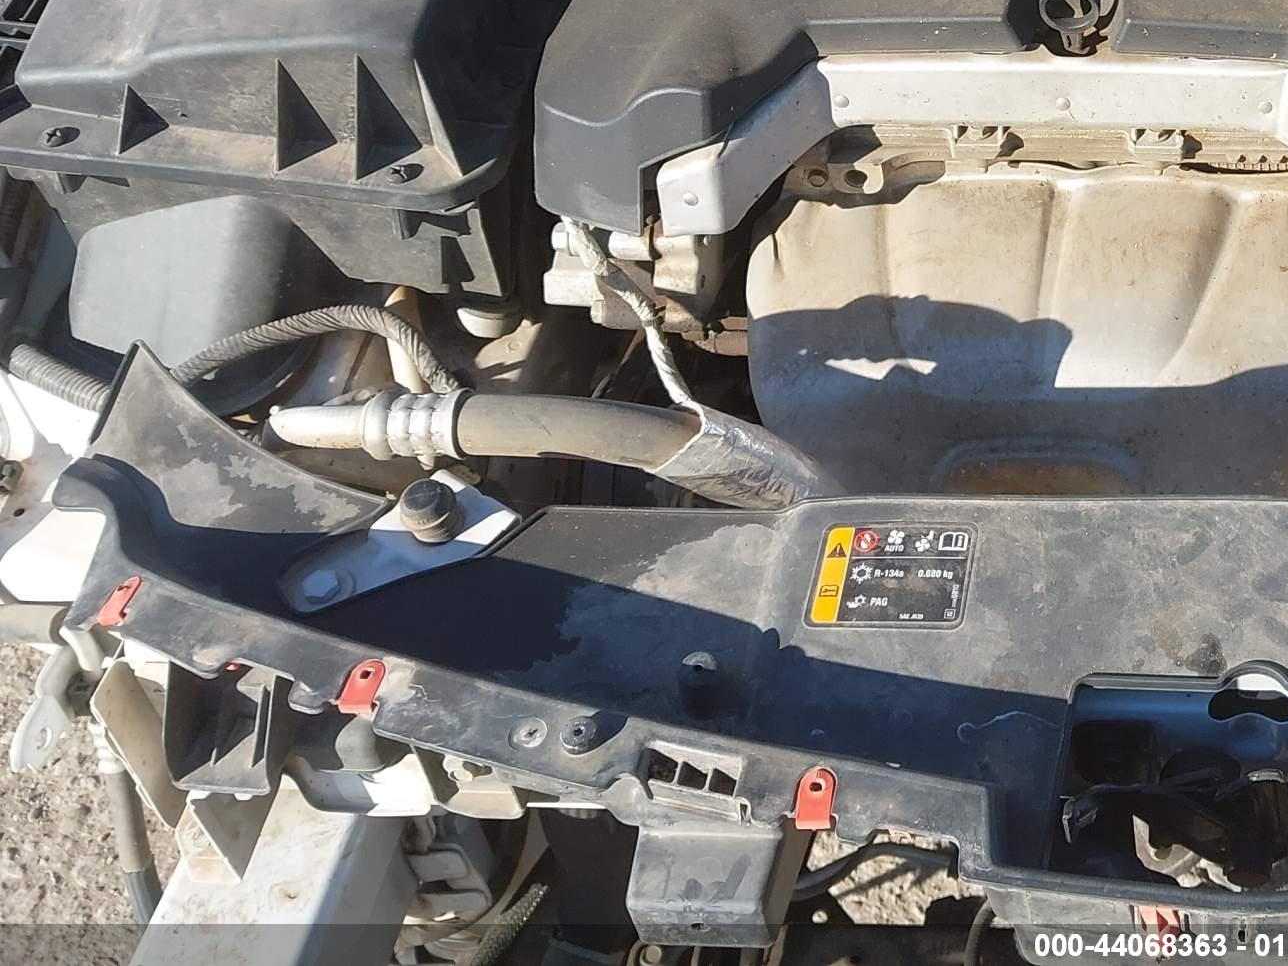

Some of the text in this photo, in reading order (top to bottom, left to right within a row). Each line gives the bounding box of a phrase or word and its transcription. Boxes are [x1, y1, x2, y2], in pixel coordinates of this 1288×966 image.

[874, 569, 953, 579] R-134a 0.680 kg
[870, 597, 888, 606] PAG
